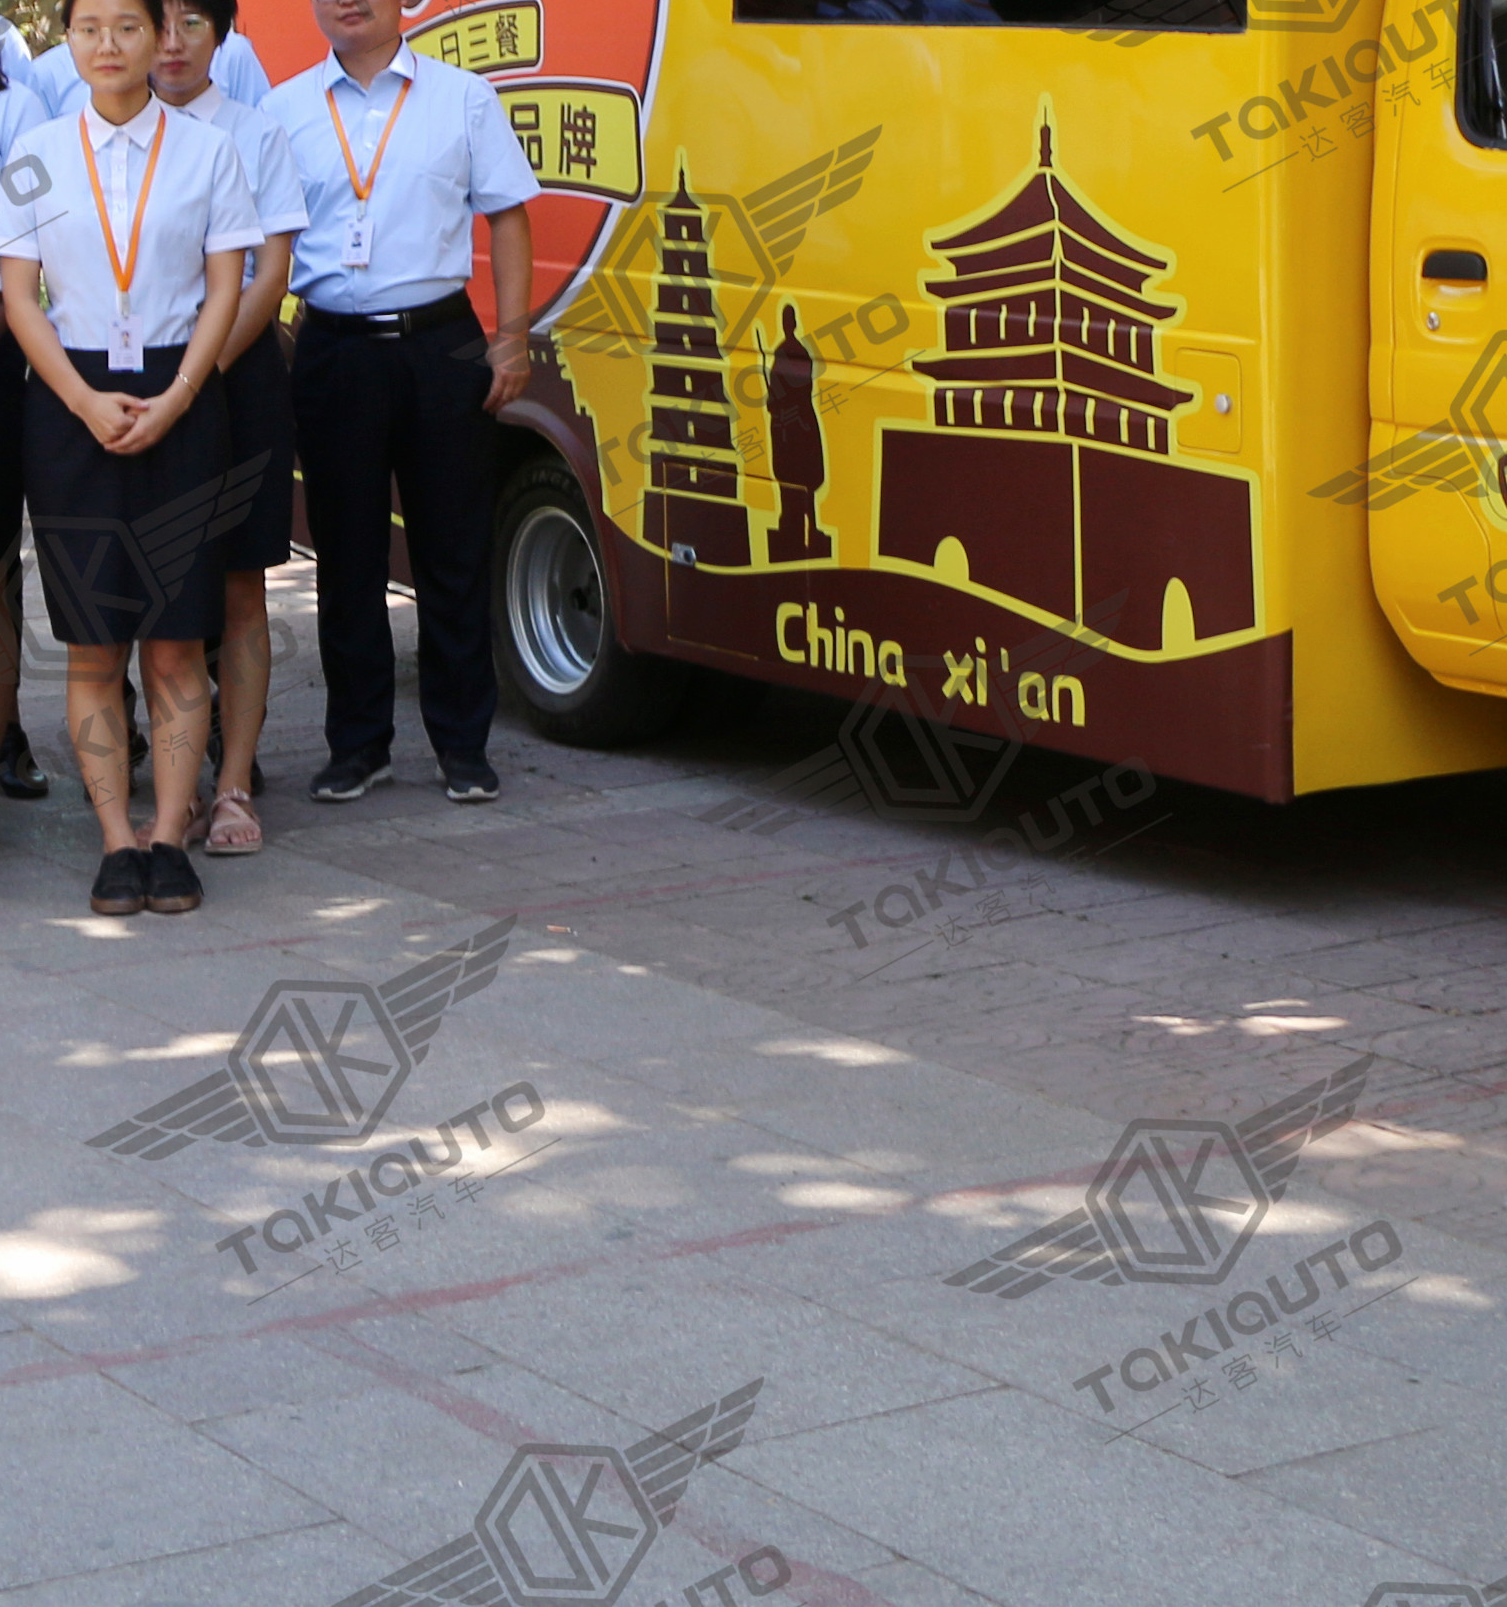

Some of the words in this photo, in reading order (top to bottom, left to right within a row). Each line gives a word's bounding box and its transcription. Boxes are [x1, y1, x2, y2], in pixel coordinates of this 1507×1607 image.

[431, 12, 519, 69] 日三餐
[776, 601, 908, 688] China
